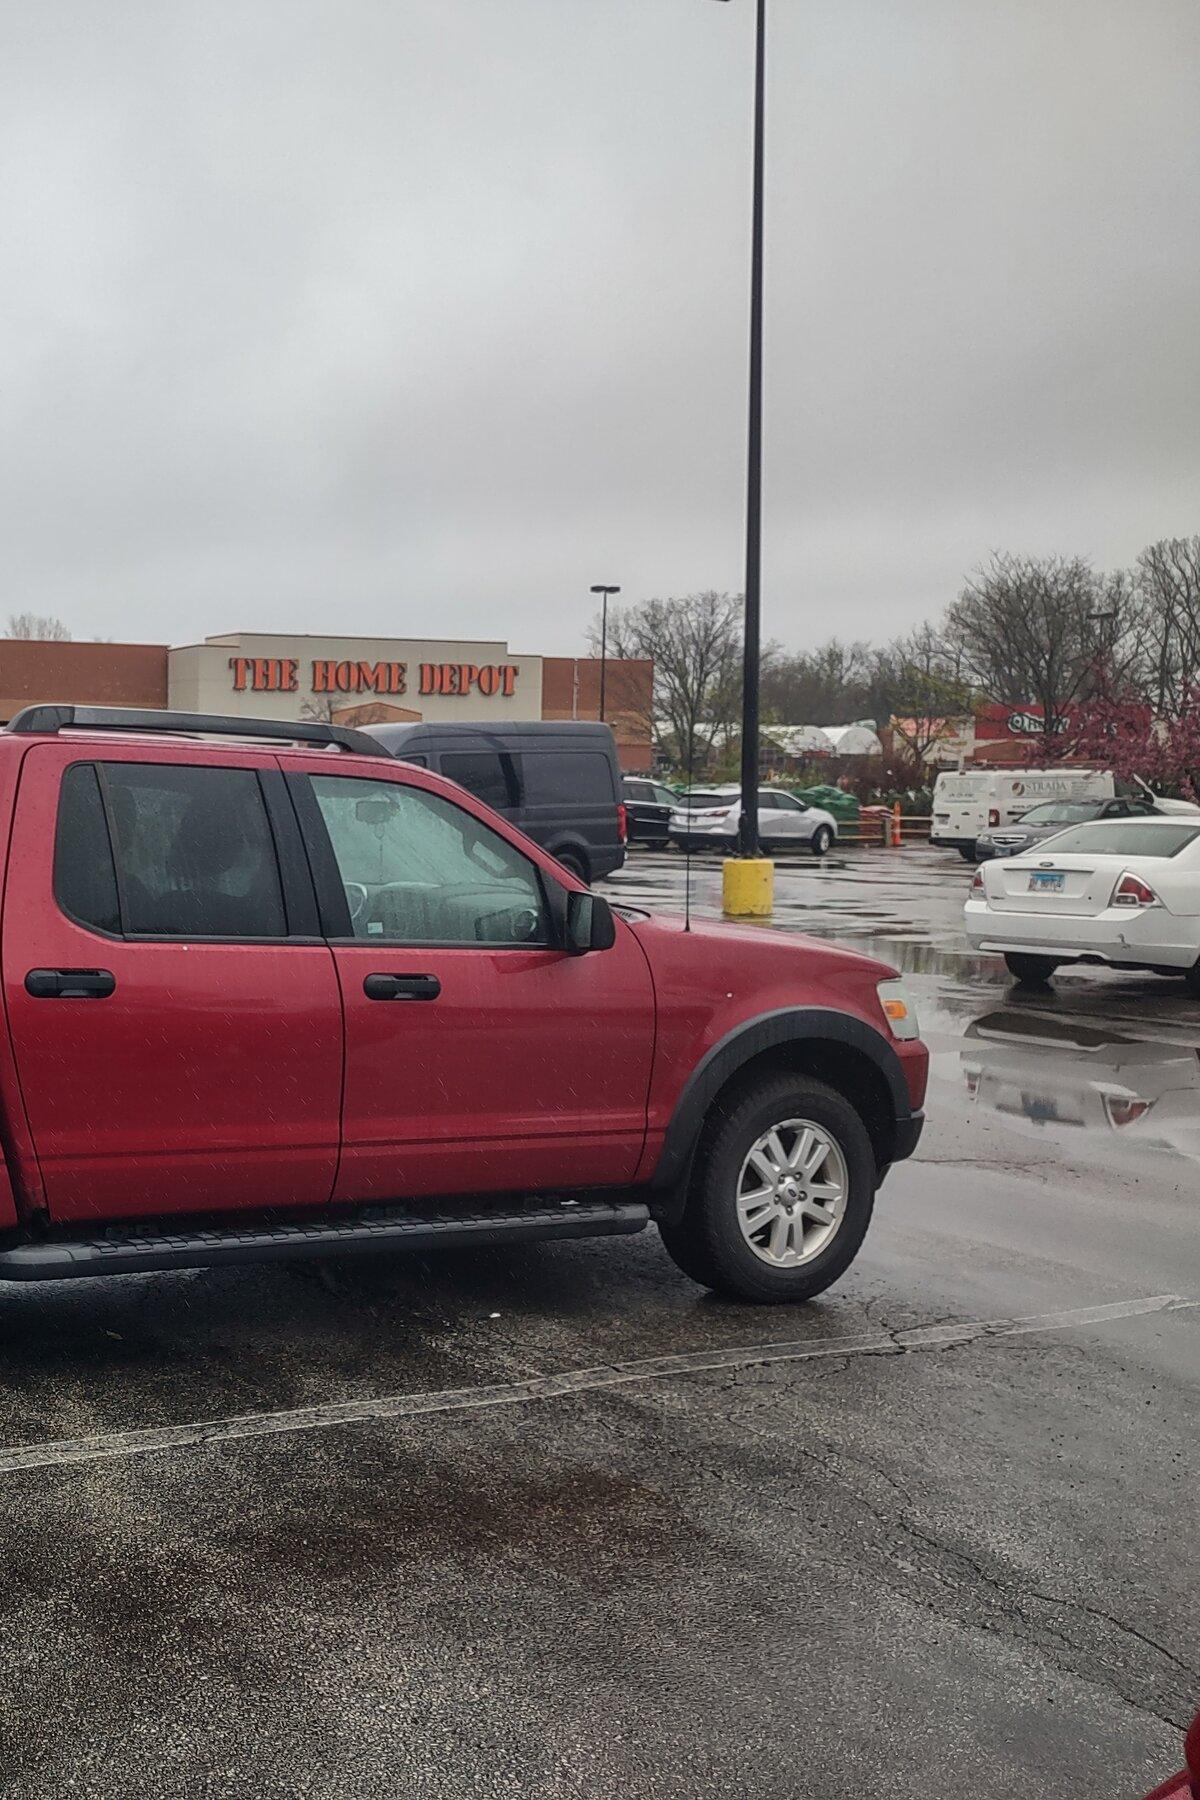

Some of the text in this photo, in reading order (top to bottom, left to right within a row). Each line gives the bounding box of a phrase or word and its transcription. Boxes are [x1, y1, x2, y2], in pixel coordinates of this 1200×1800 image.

[229, 658, 519, 697] THE HOME DEPOT
